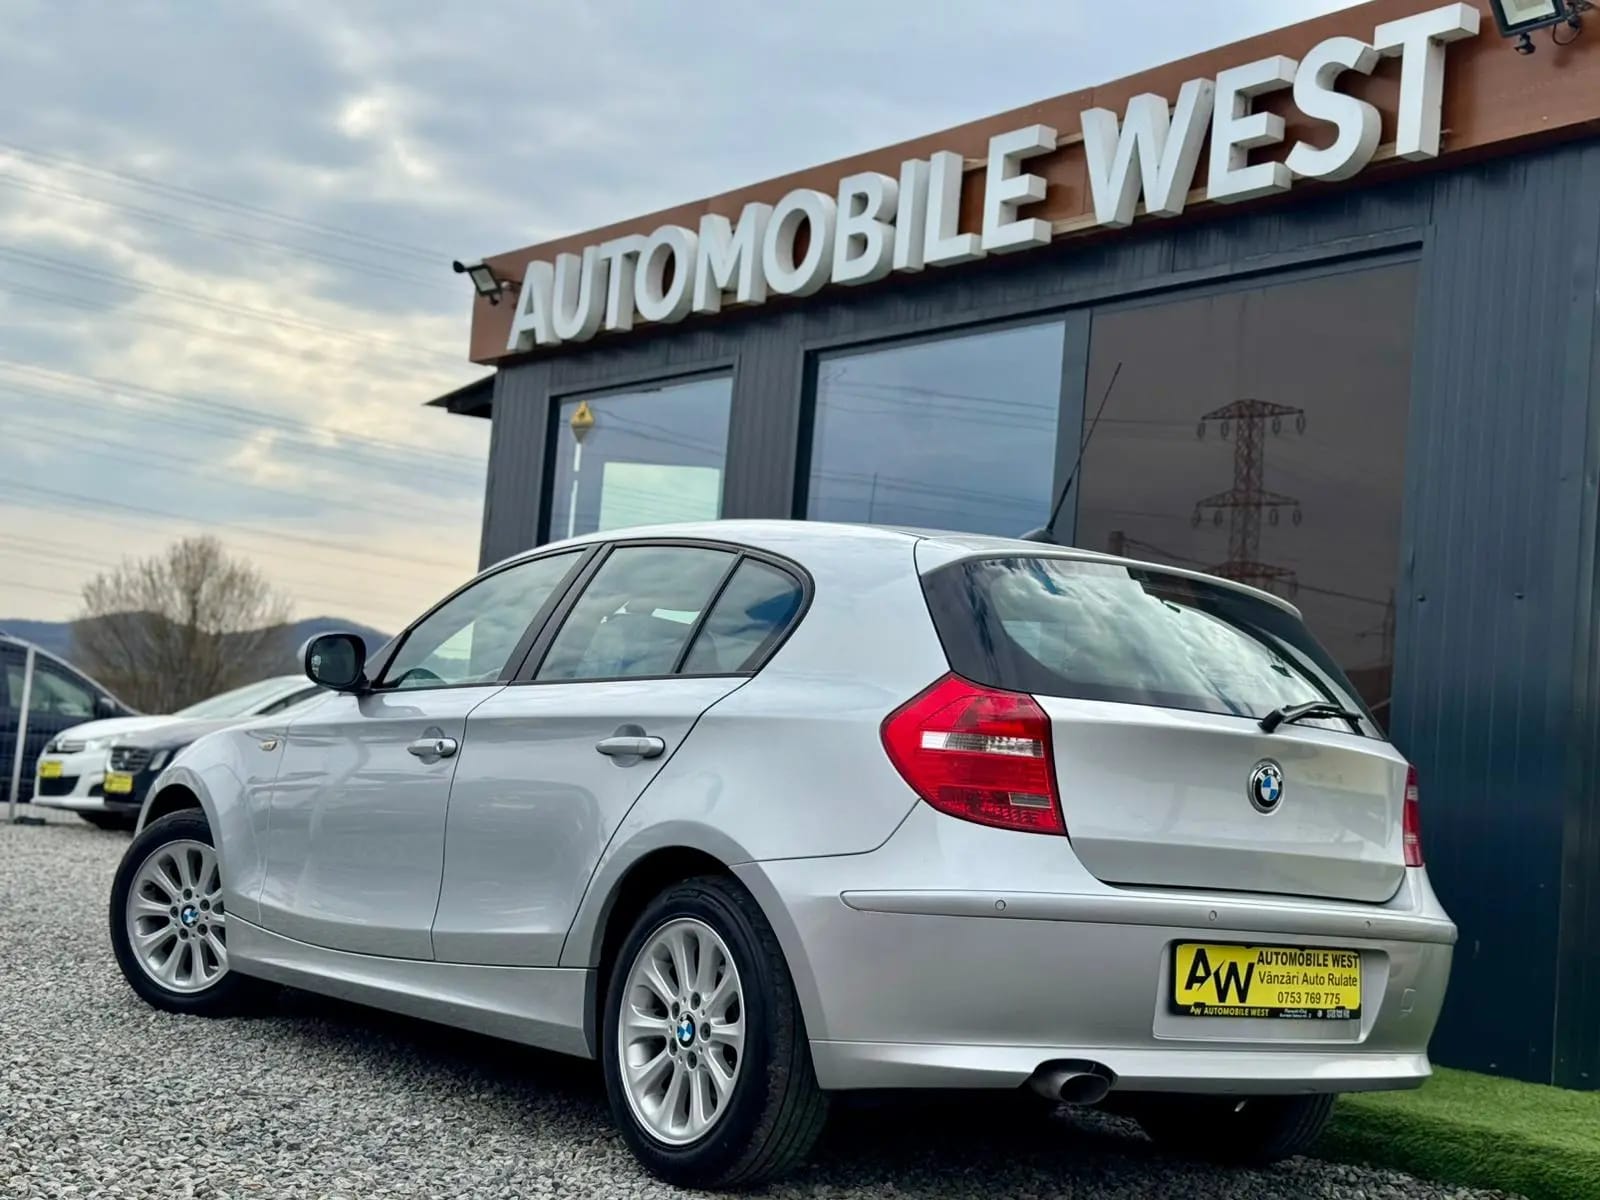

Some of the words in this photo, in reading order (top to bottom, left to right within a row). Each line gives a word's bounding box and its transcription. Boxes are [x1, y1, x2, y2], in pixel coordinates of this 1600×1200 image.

[507, 123, 1058, 353] AUTOMOBILE
[1080, 2, 1480, 229] WEST
[1257, 951, 1328, 967] AUTOMOBILE
[1331, 954, 1360, 969] WEST
[1301, 972, 1325, 986] Auto
[1328, 972, 1358, 987] Rulate
[1277, 991, 1302, 1004] 0753
[1304, 992, 1321, 1005] 769
[1323, 992, 1341, 1005] 775
[1204, 1007, 1249, 1016] AUTOMOBILE
[1250, 1008, 1269, 1017] WEST
